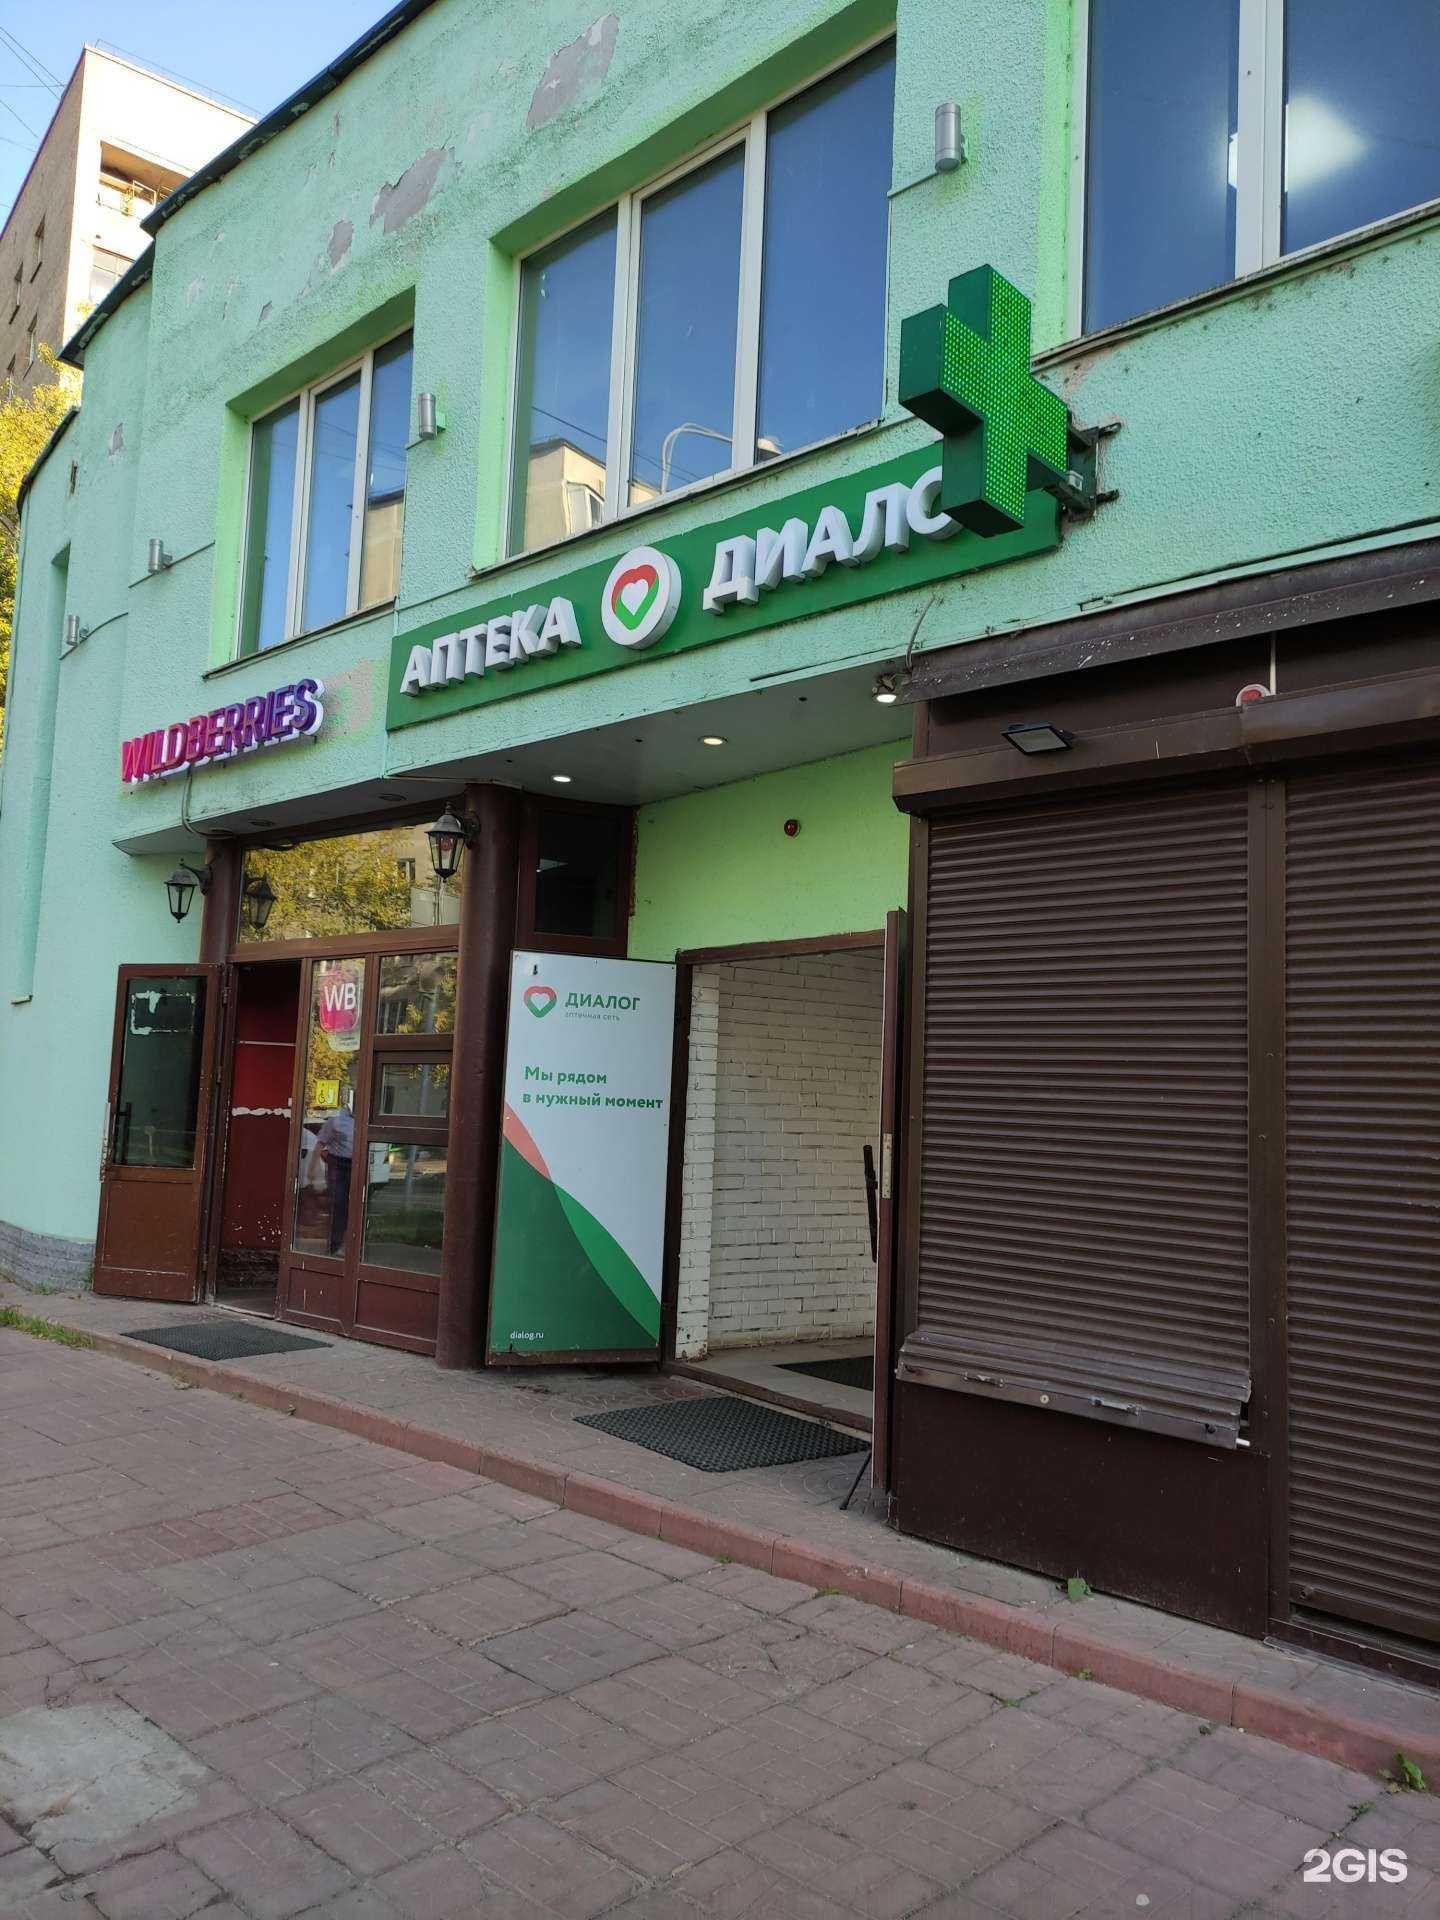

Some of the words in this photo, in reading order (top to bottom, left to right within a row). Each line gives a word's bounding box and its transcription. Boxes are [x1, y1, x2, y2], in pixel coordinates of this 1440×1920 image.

[399, 597, 582, 697] АПТЕКА
[702, 465, 963, 615] ДИАЛО
[121, 678, 325, 785] WILDBERRIES
[324, 982, 357, 1012] WB
[565, 992, 641, 1011] ДИАЛОГ
[524, 1066, 553, 1081] Мы
[557, 1072, 608, 1085] рядом
[522, 1093, 532, 1103] в
[535, 1092, 602, 1107] нужный
[605, 1097, 664, 1109] момент
[510, 1330, 544, 1340] dialog.ru
